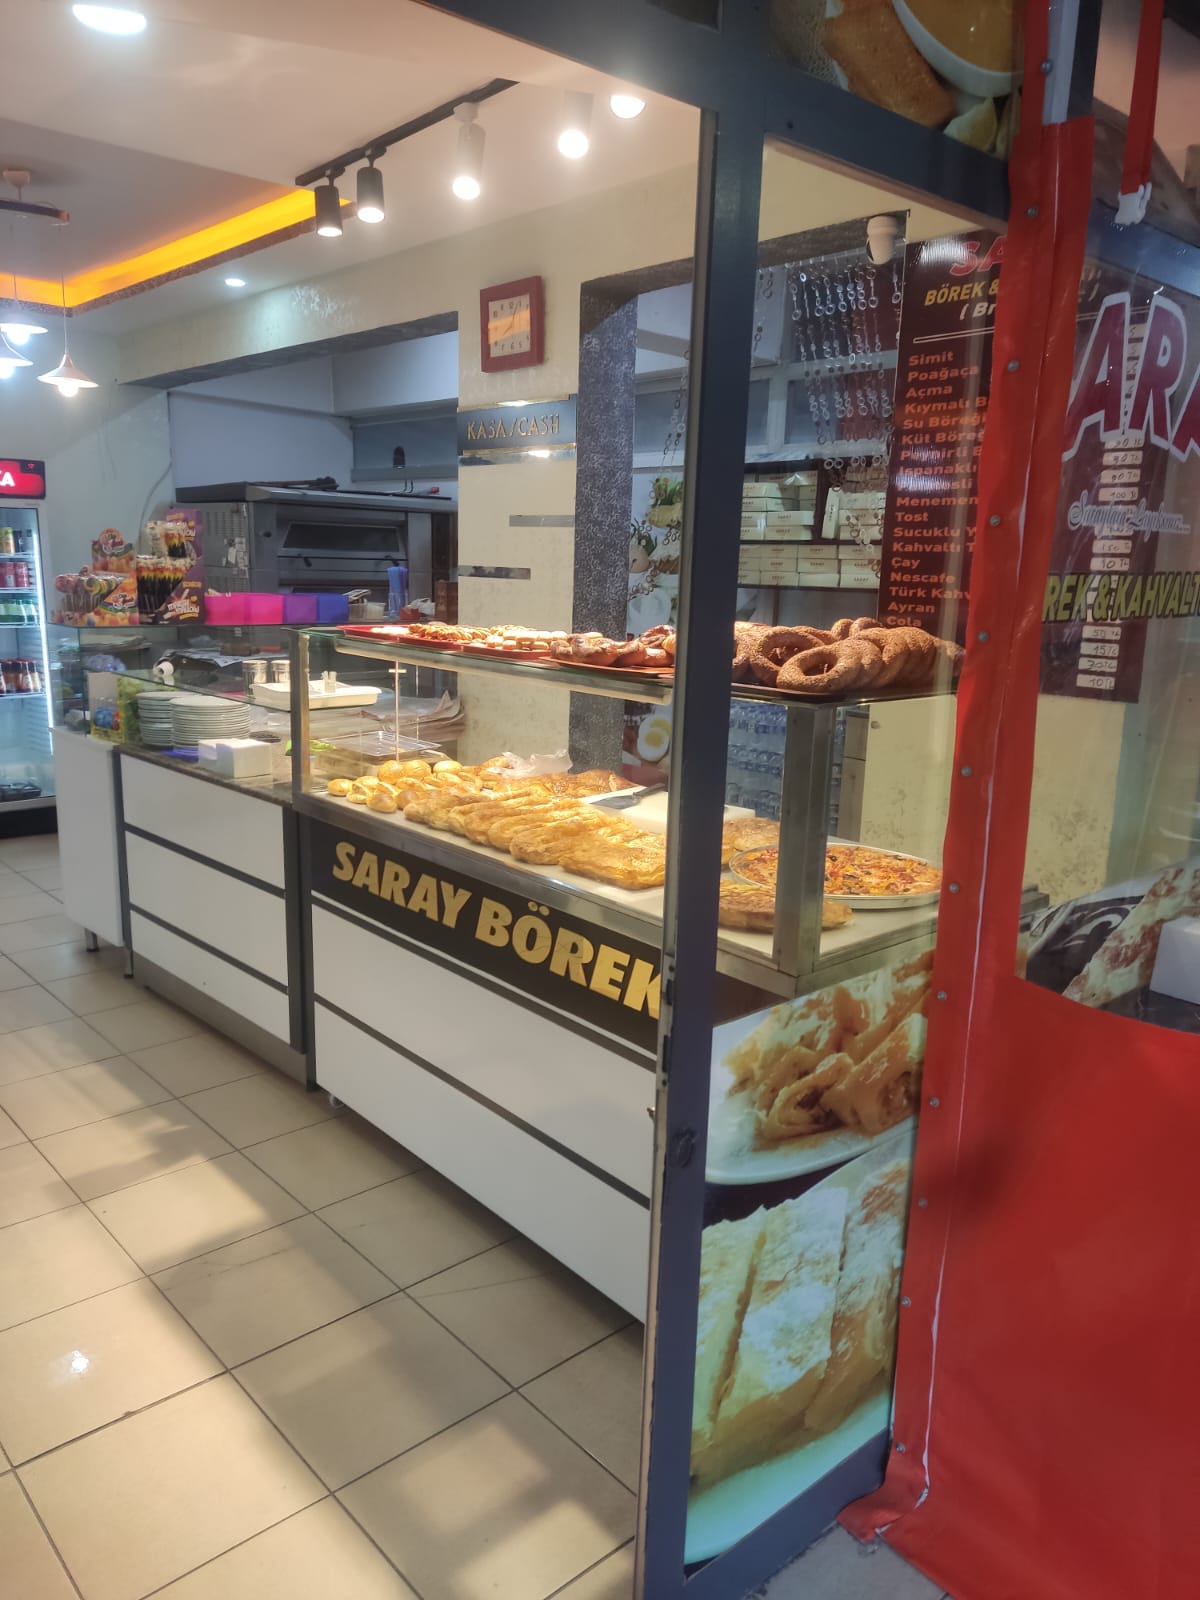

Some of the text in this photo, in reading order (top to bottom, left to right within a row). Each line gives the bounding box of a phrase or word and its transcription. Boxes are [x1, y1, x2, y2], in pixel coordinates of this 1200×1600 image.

[924, 278, 999, 306] BÖREK &
[908, 351, 954, 367] Simit
[907, 366, 979, 384] Poağaça
[1061, 290, 1200, 463] AR
[905, 386, 953, 401] Açma
[904, 400, 970, 415] Kıymalı
[902, 420, 924, 430] Su
[901, 433, 930, 445] Kül
[896, 497, 978, 507] Menemen
[895, 512, 929, 522] Tost
[893, 527, 961, 537] Sucuklu
[892, 542, 961, 553] Kahvaltı
[891, 557, 920, 570] Çay
[1102, 558, 1129, 568] 10 TL
[890, 572, 956, 583] Nescafe
[889, 587, 926, 598] Türk
[1041, 574, 1091, 622] REK
[1092, 573, 1111, 621] &
[887, 602, 935, 614] Ayran
[886, 616, 922, 627] Cola
[332, 841, 662, 1020] SARAY BÖREK
